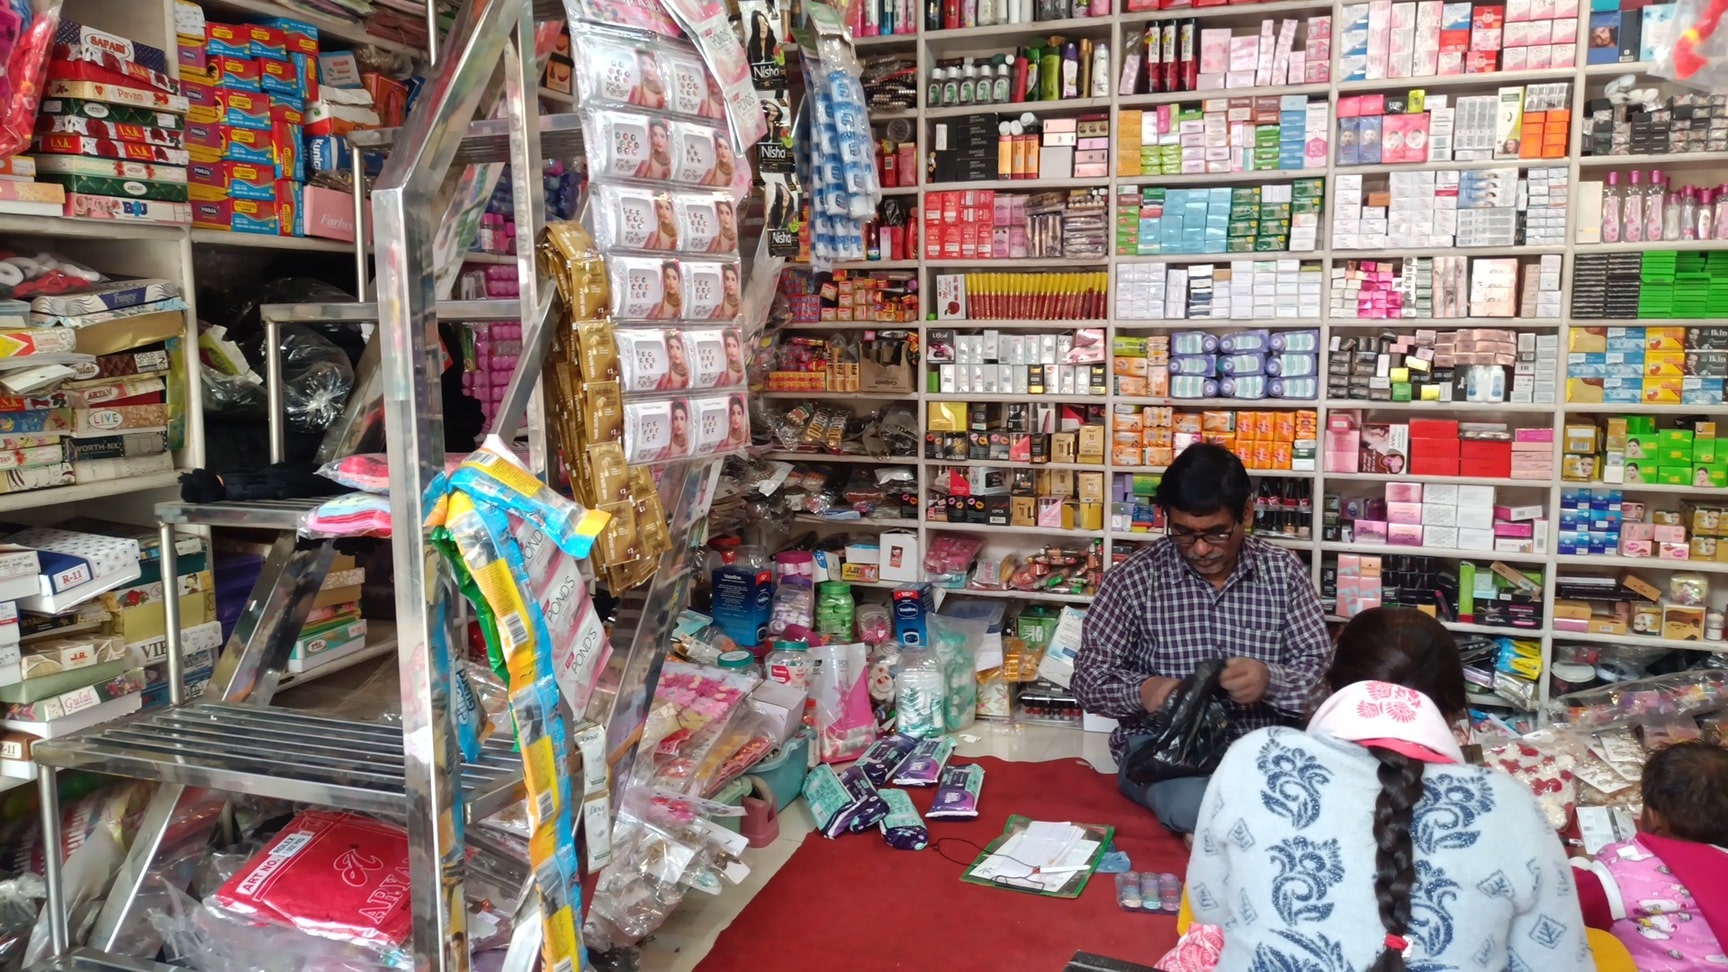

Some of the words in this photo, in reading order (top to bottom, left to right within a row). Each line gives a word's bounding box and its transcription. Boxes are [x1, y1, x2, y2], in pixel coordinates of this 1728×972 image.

[90, 35, 126, 54] SAFARI
[753, 66, 779, 79] Nisha
[117, 89, 143, 101] Pavan
[761, 145, 786, 159] Nisha
[88, 387, 113, 400] ARTAN
[93, 413, 119, 425] LIVE
[61, 570, 82, 584] R-11
[547, 575, 576, 624] POND'S
[572, 626, 597, 675] POND'S
[456, 668, 476, 712] Guard
[243, 873, 263, 892] ART
